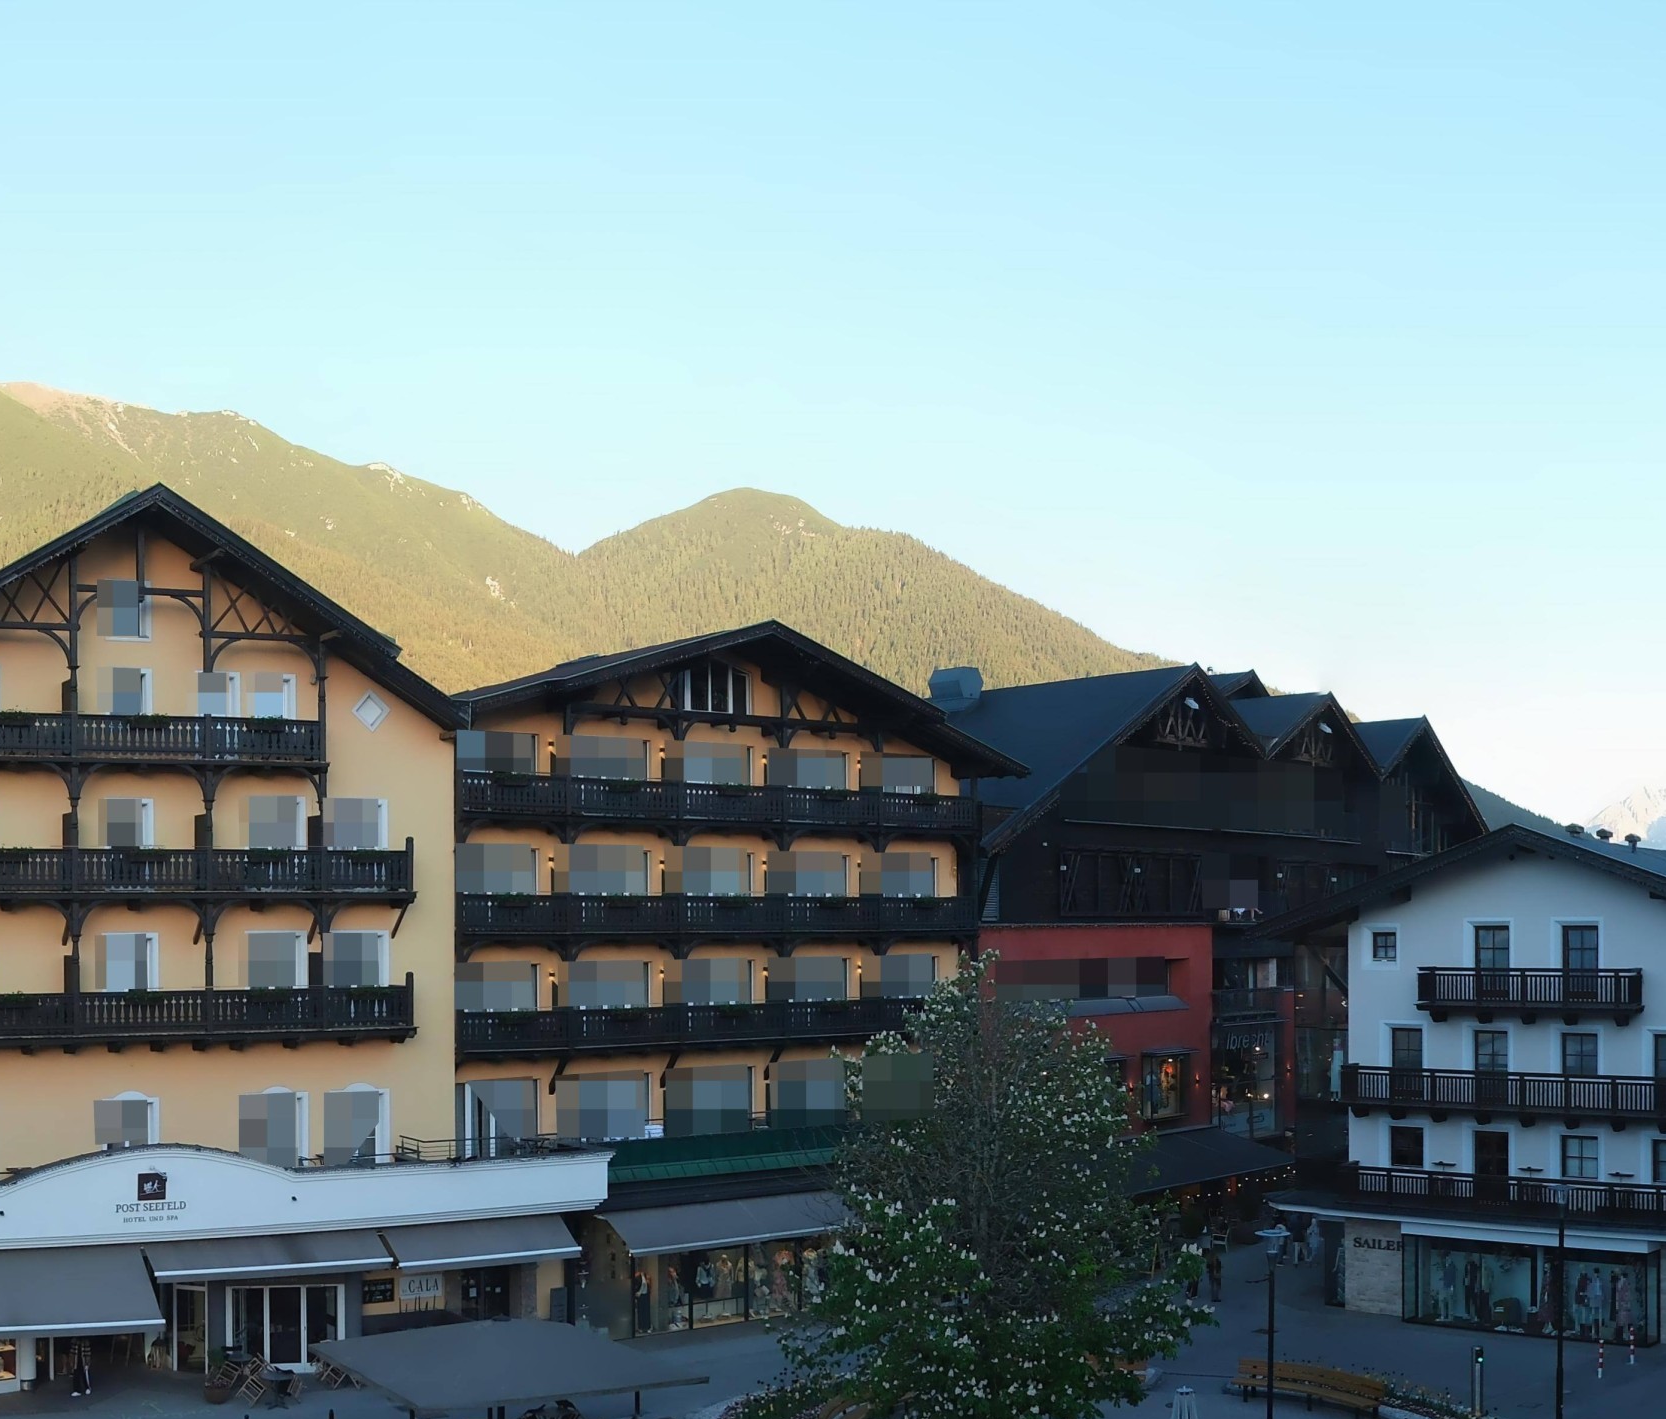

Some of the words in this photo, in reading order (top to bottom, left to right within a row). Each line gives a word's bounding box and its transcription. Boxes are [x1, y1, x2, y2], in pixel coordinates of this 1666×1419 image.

[116, 1203, 140, 1213] POST
[143, 1201, 186, 1212] SEEFELD
[408, 1278, 439, 1293] CALA
